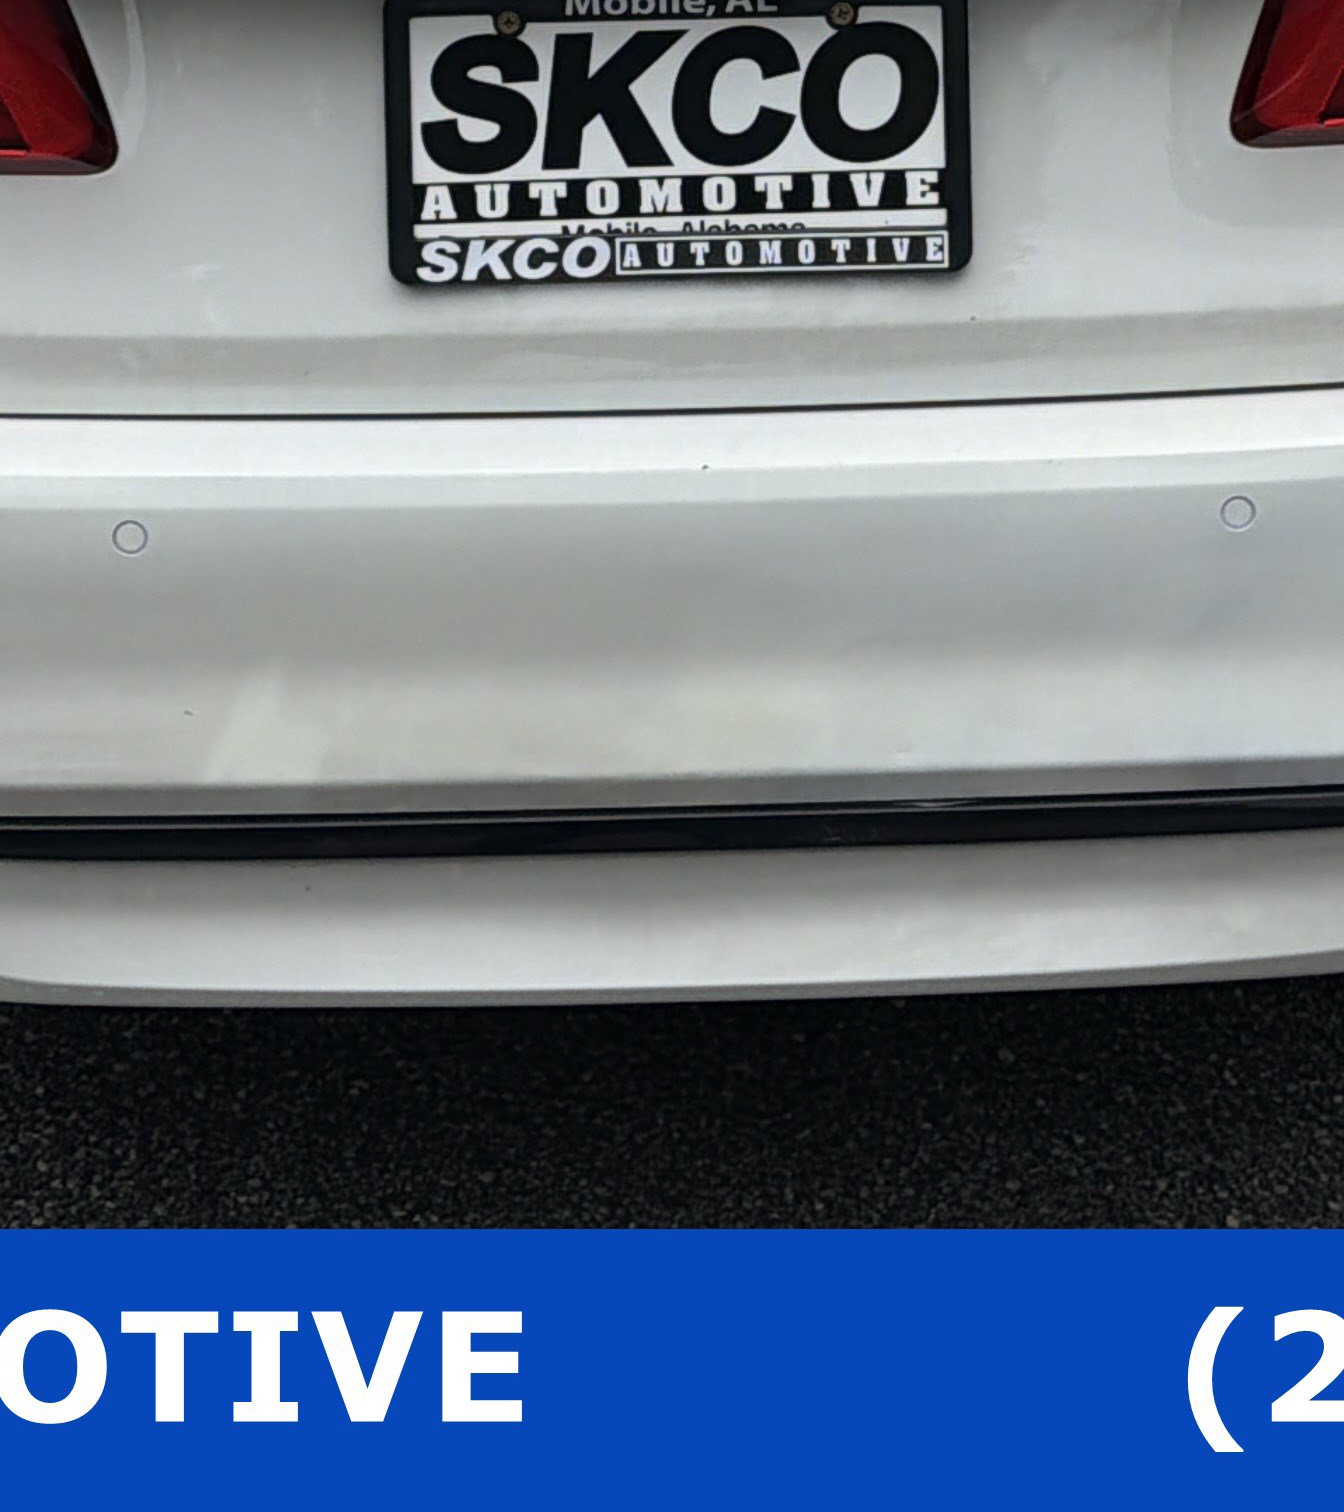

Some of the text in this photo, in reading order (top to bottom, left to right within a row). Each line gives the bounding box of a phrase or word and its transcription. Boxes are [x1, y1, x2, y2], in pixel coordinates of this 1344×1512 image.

[420, 20, 940, 175] SKCO
[420, 170, 940, 221] AUTOMOTIVE
[416, 236, 945, 283] SKCO AUTOMOTIVE
